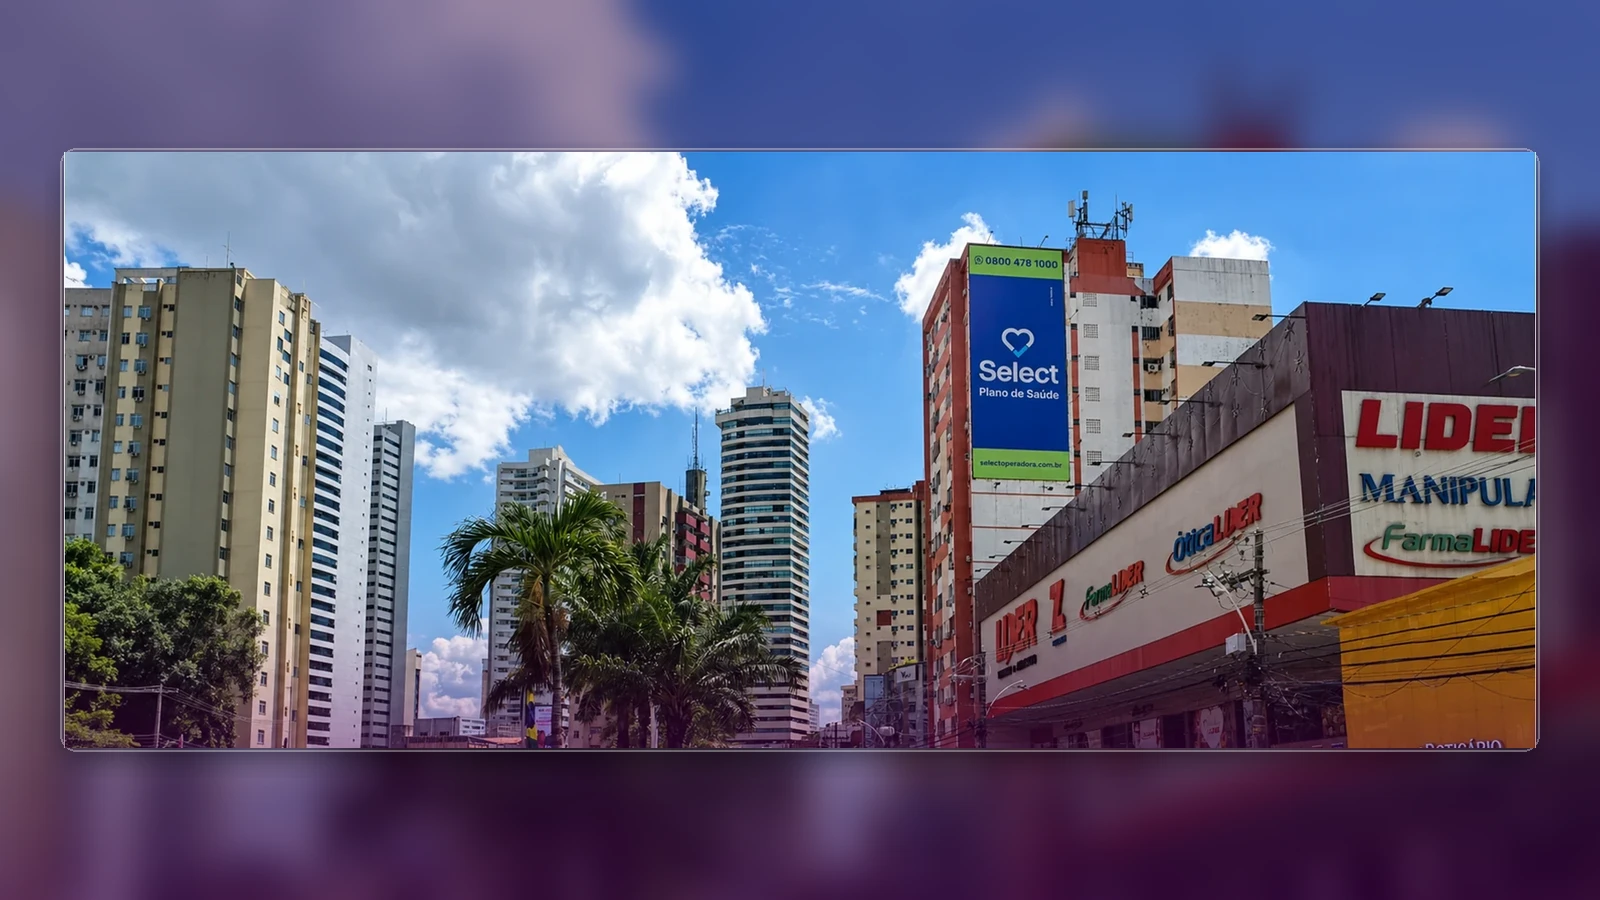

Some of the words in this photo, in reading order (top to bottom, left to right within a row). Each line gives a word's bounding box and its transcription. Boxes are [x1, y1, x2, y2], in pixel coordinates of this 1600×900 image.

[985, 256, 1011, 266] 0800
[1013, 258, 1032, 268] 478
[1034, 260, 1059, 269] 1000
[979, 360, 1060, 385] Select
[979, 387, 1009, 398] Plano
[1010, 388, 1025, 399] de
[1026, 389, 1060, 400] Saúde
[980, 459, 1063, 469] selectoperadora.com.br
